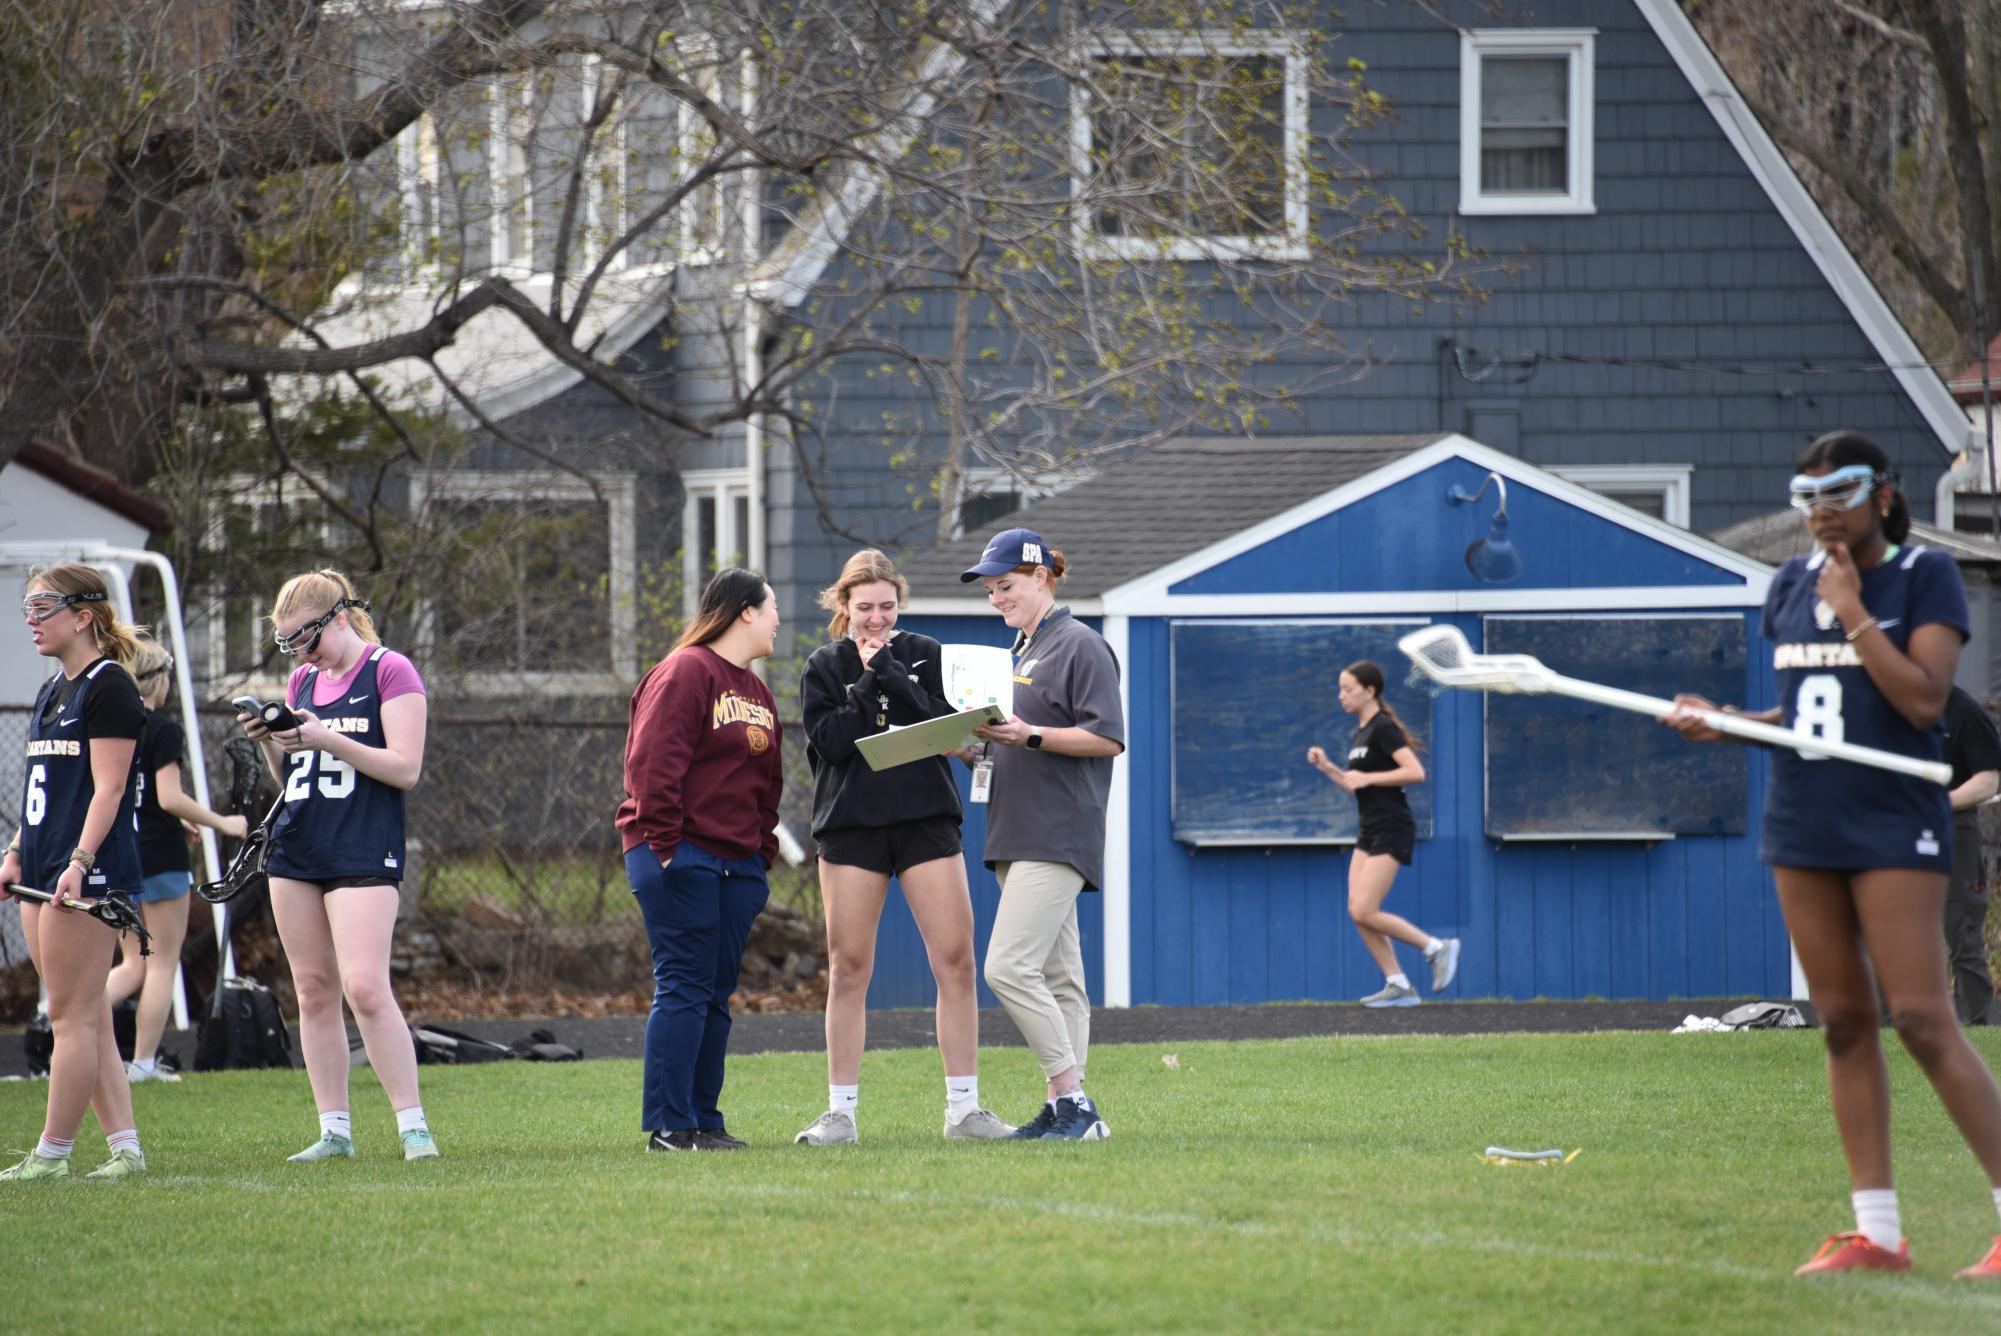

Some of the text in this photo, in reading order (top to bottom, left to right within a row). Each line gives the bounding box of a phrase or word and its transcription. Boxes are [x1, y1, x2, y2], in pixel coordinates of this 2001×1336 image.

[1774, 643, 1863, 670] SPARTA
[1793, 674, 1845, 760] 8
[26, 764, 47, 826] 6
[285, 750, 356, 803] 25
